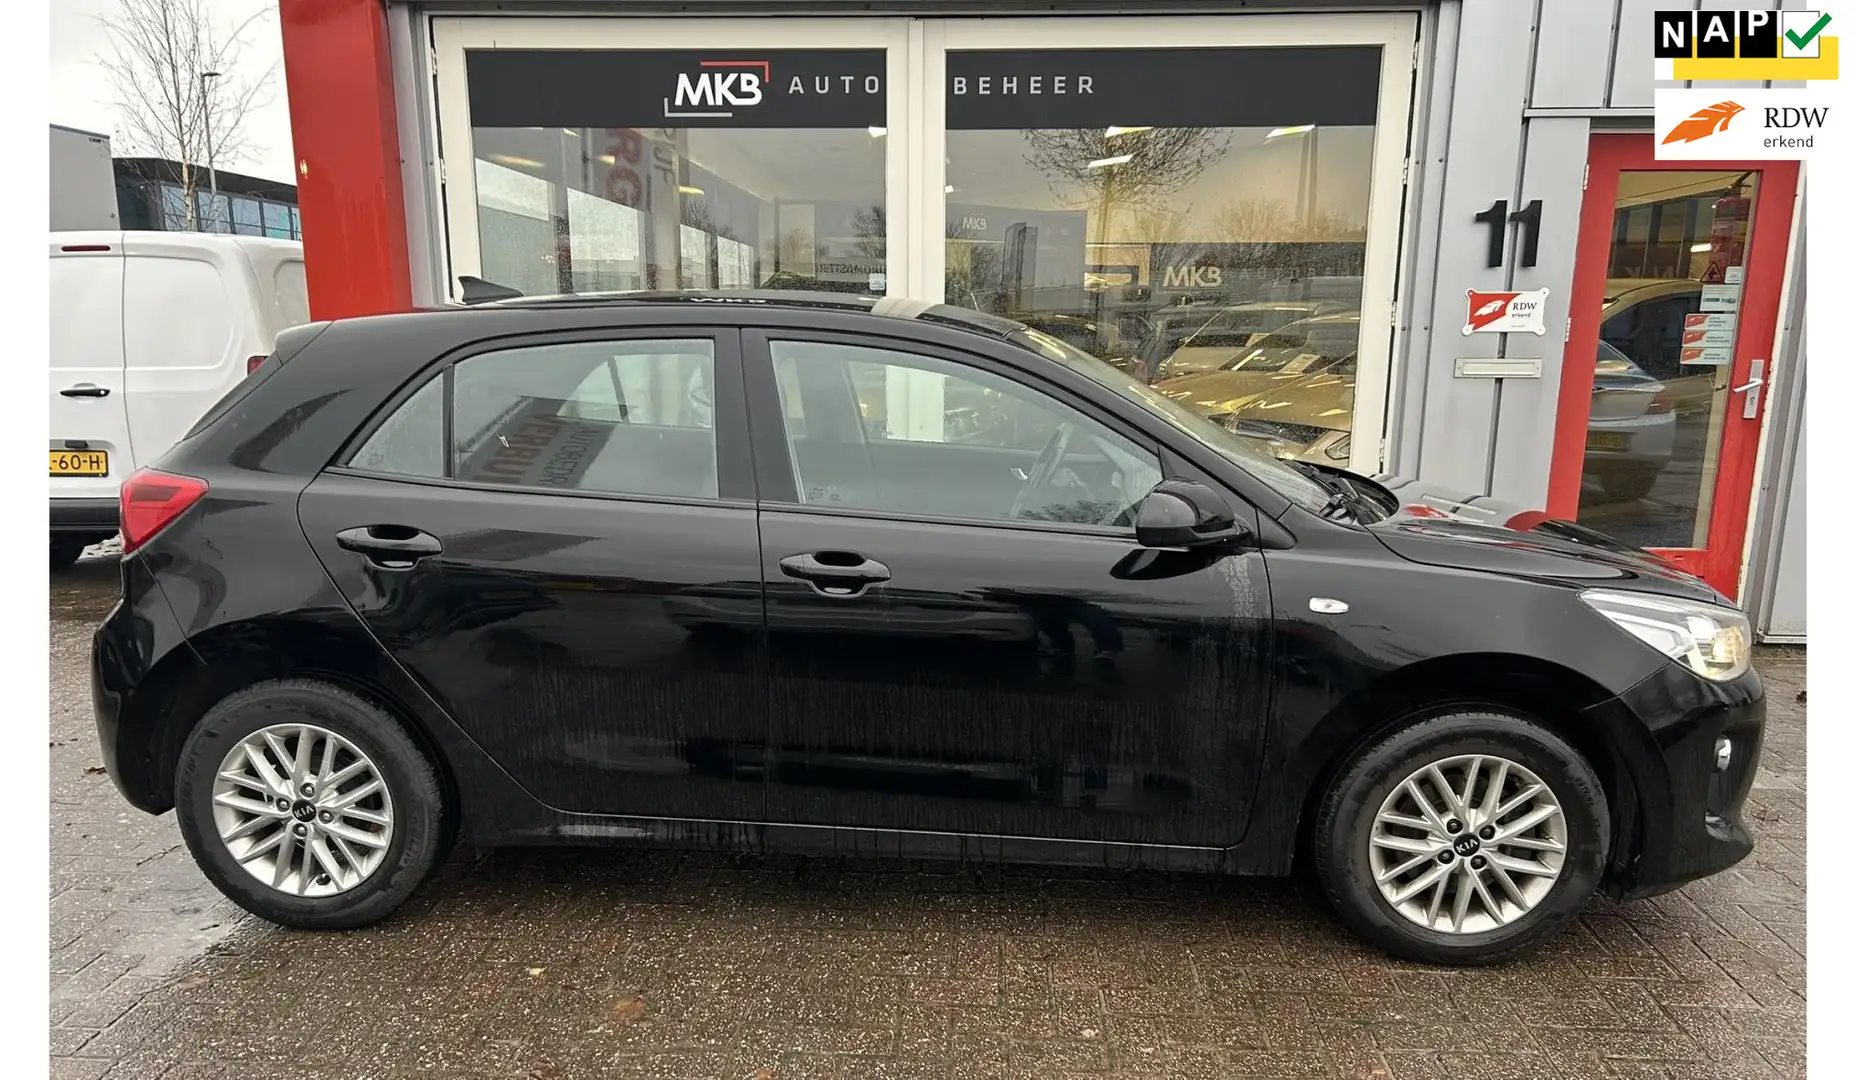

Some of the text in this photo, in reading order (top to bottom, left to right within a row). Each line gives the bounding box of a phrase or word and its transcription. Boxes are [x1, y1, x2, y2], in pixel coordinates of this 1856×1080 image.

[675, 73, 1094, 106] MKB AUTO BEHEER
[1474, 200, 1543, 268] 11
[1162, 266, 1222, 287] MKB
[1512, 302, 1537, 311] RDW
[49, 454, 100, 470] -60-H
[295, 805, 314, 818] KIA
[1456, 839, 1478, 853] KIA
